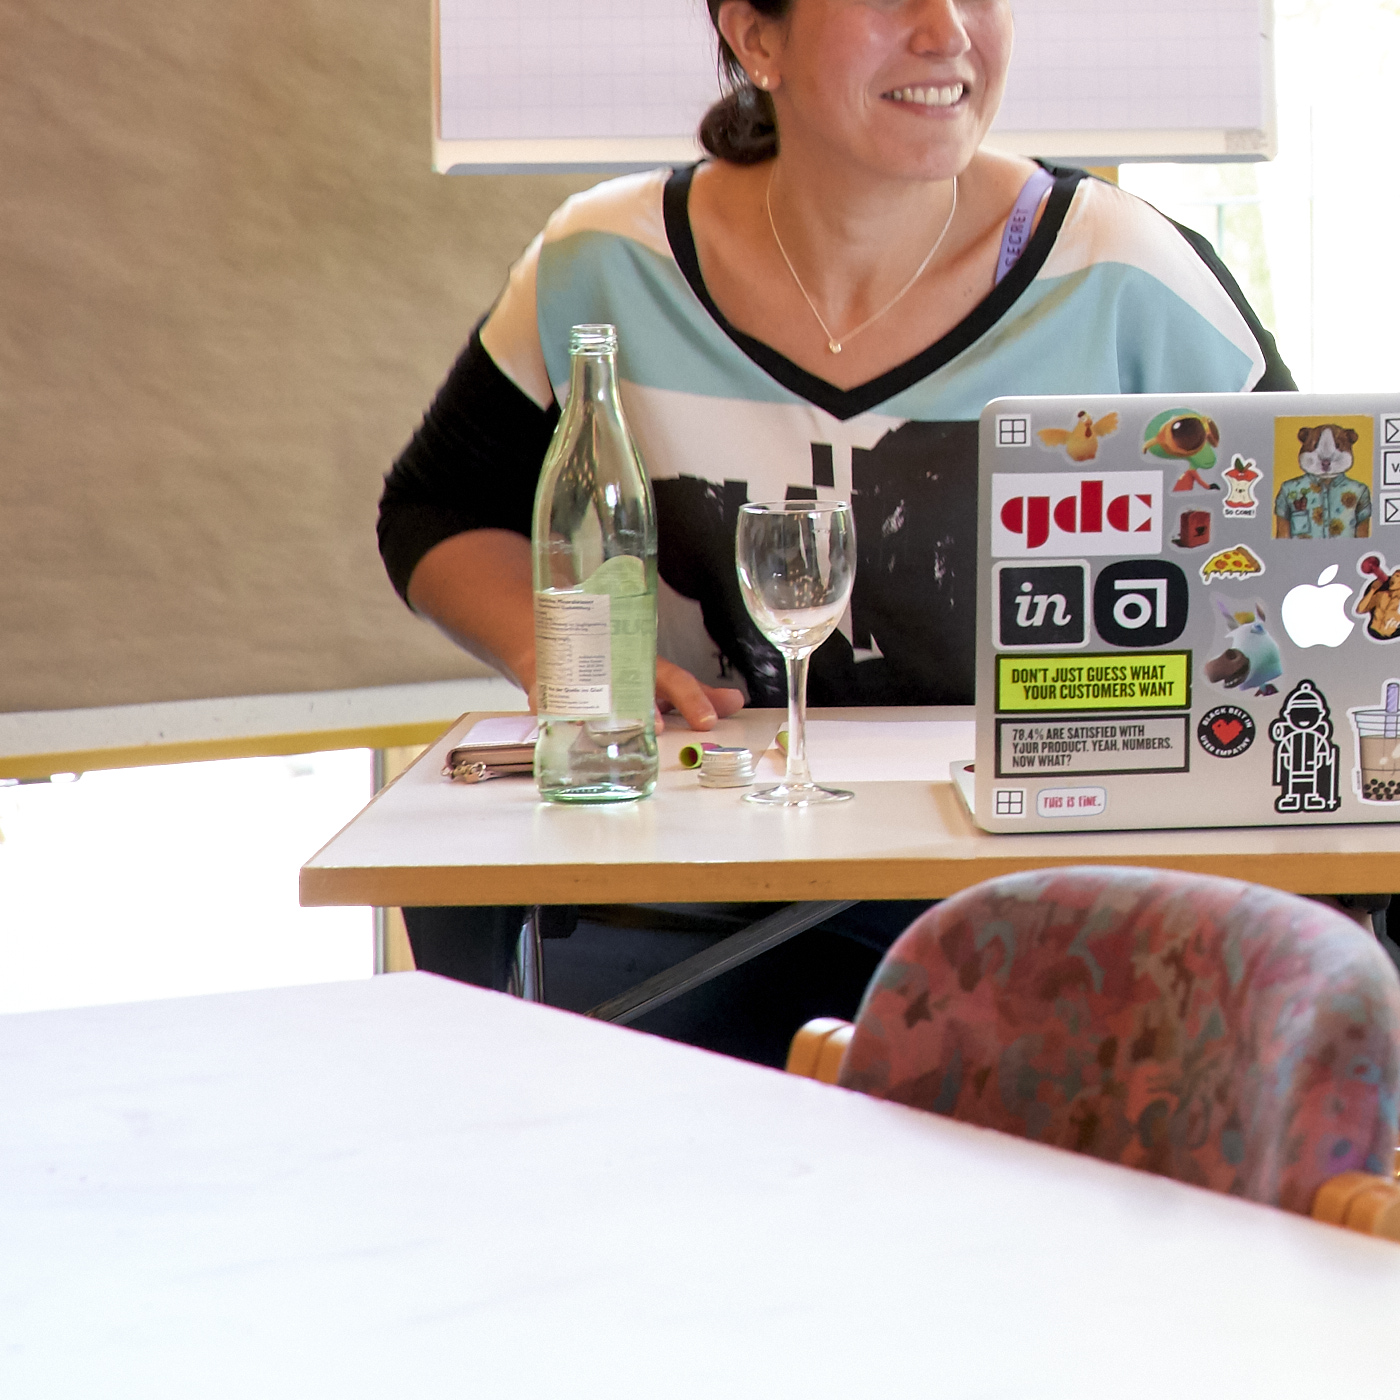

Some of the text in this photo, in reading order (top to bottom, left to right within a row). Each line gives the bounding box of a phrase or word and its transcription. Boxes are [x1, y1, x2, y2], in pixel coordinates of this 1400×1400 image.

[1000, 480, 1152, 549] gdc
[1014, 581, 1072, 628] in
[1011, 665, 1166, 683] DON'T JUST GUESS WHAT
[1023, 681, 1174, 700] YOUR CUSTOMERS WANT
[1201, 707, 1252, 729] BLACK BELT IN
[1012, 725, 1145, 741] 78.4% ARE SATISFIED WITH
[1041, 739, 1090, 753] PRODUCT.
[1092, 738, 1120, 752] YEAH,
[1122, 737, 1173, 751] NUMBERS.
[1200, 734, 1250, 756] USER EMPATHY
[1012, 754, 1072, 768] NOW WHAT?
